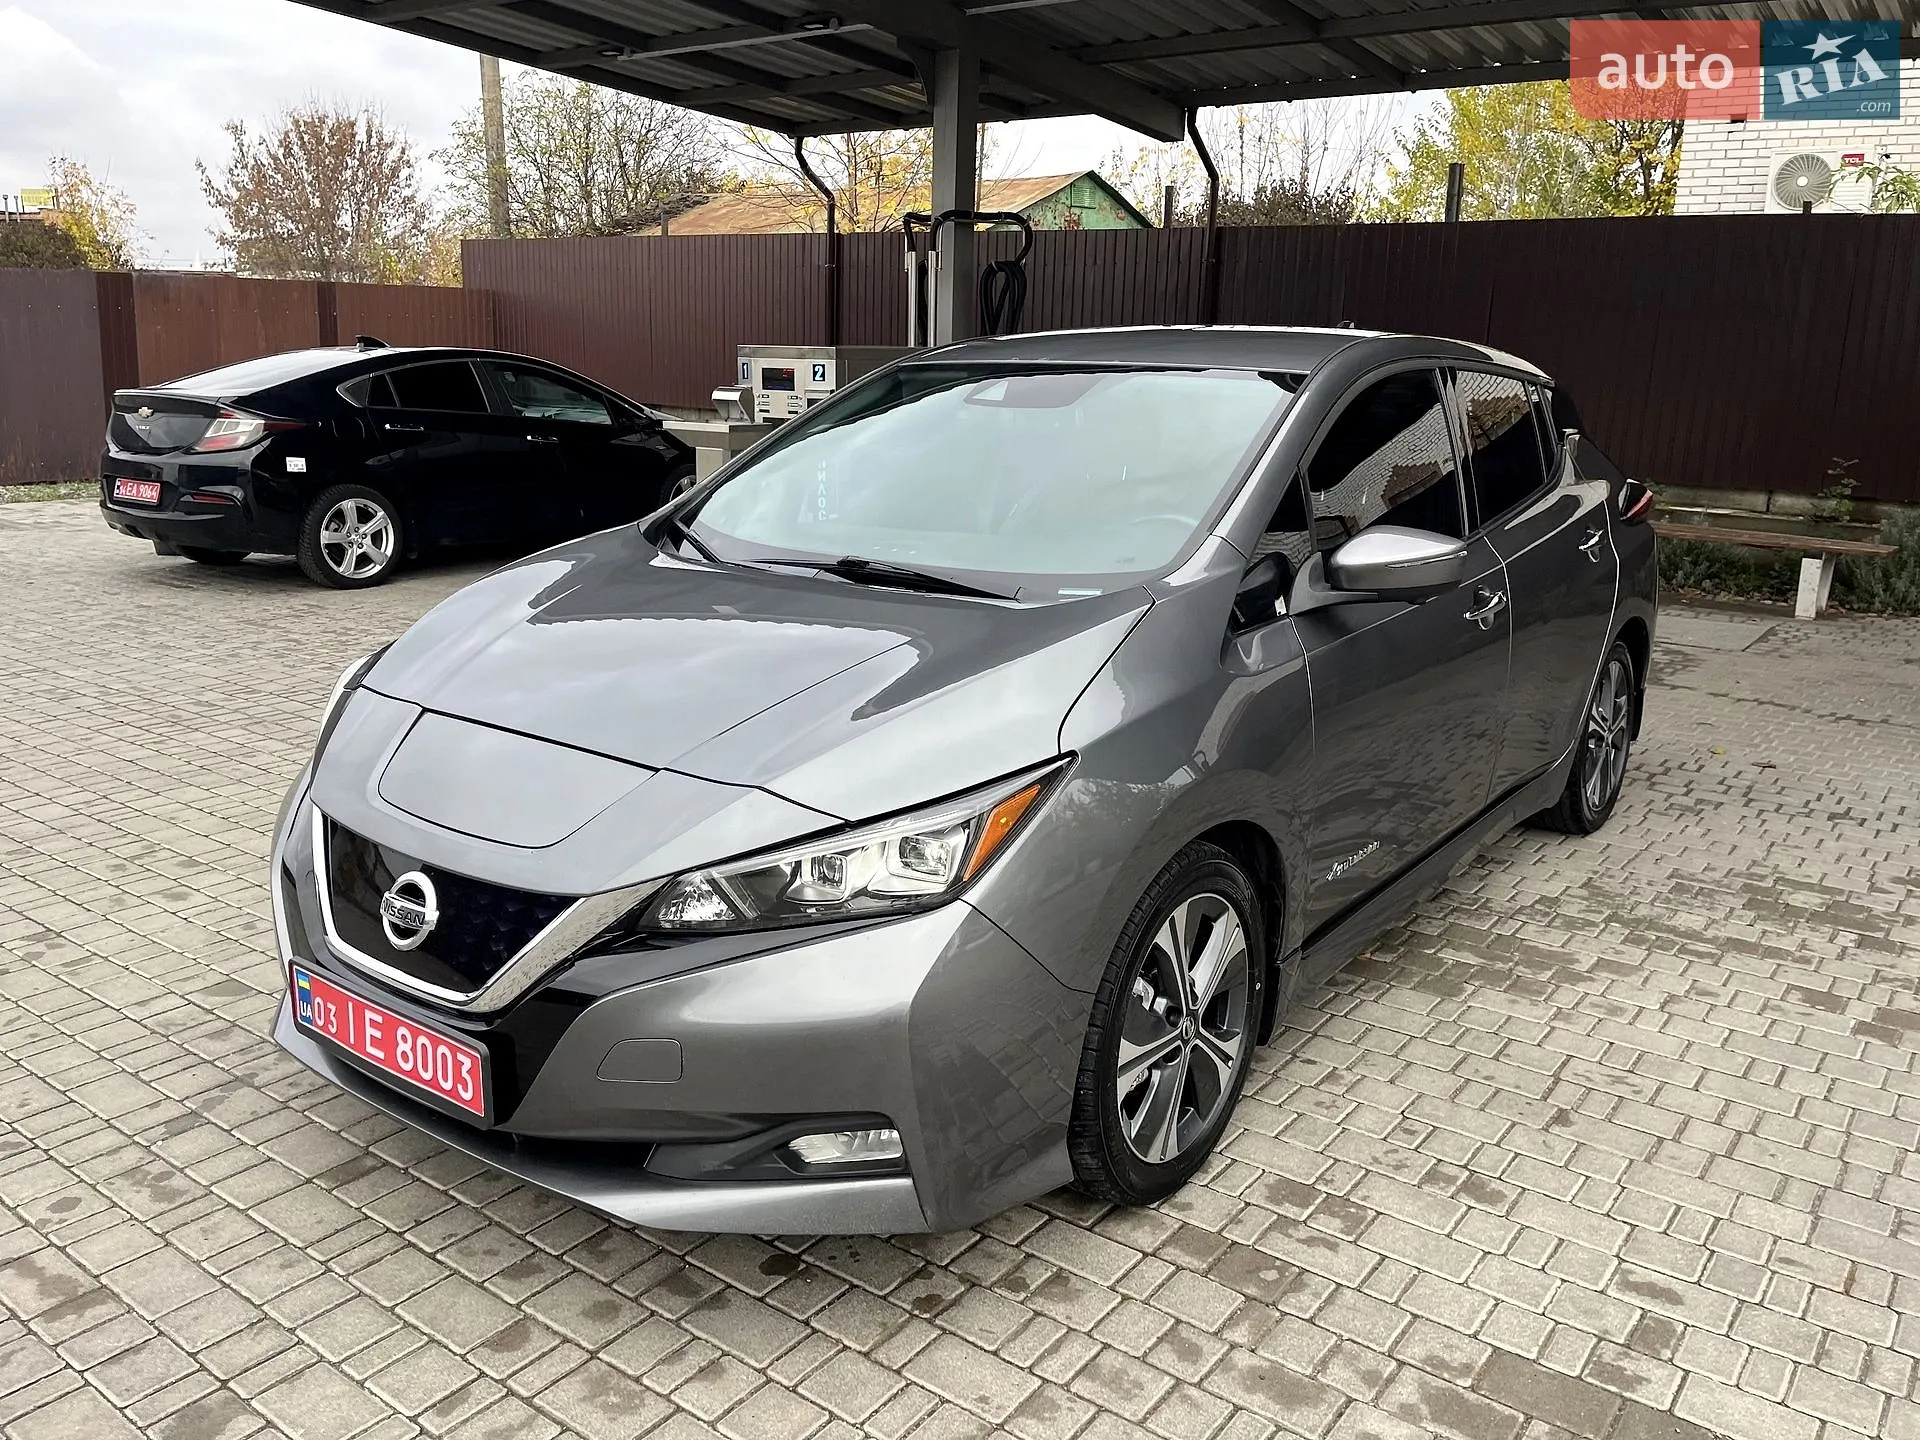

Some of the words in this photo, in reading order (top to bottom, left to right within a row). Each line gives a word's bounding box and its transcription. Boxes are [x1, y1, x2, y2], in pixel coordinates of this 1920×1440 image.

[814, 365, 824, 381] 2
[382, 897, 425, 927] NISSAN
[300, 1000, 313, 1020] UA
[314, 996, 338, 1034] 03
[348, 1001, 385, 1060] IE
[396, 1025, 474, 1101] 8003
